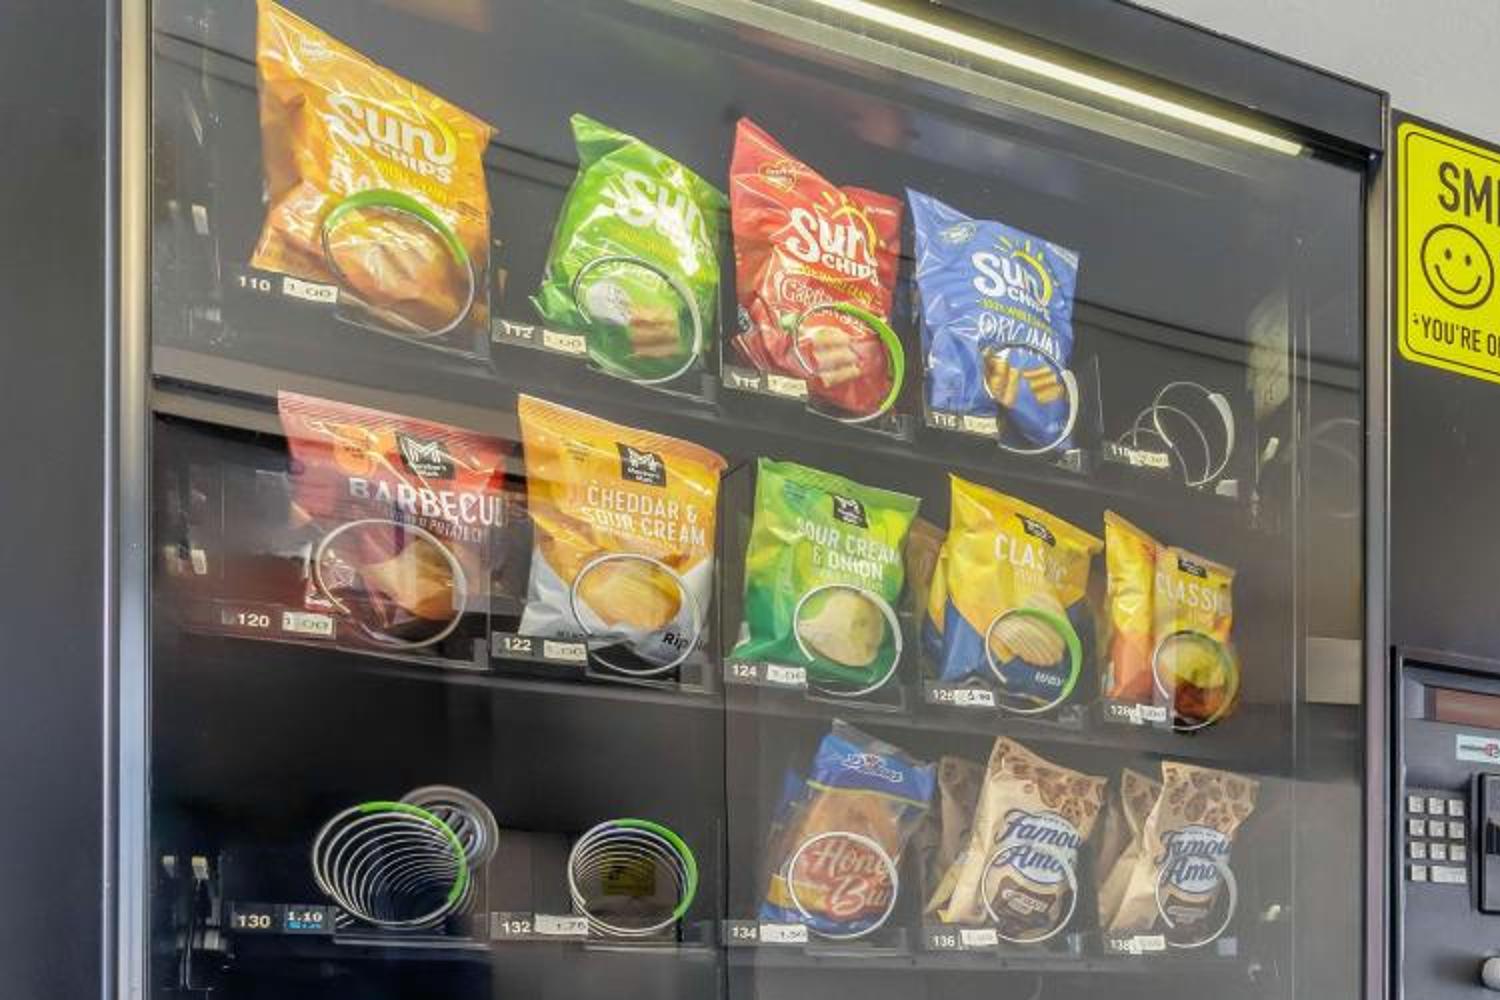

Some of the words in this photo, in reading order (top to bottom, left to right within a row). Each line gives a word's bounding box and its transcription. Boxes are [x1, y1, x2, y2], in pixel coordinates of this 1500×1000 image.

[317, 95, 458, 166] Sun
[784, 207, 877, 268] Sun
[240, 275, 271, 292] 110
[1420, 314, 1482, 353] YOU'RE
[587, 485, 680, 521] CHEDDAR
[641, 517, 706, 547] CREAM
[237, 613, 270, 628] 120
[503, 637, 532, 652] 122
[732, 664, 758, 678] 124
[238, 914, 272, 929] 130
[501, 919, 532, 934] 132
